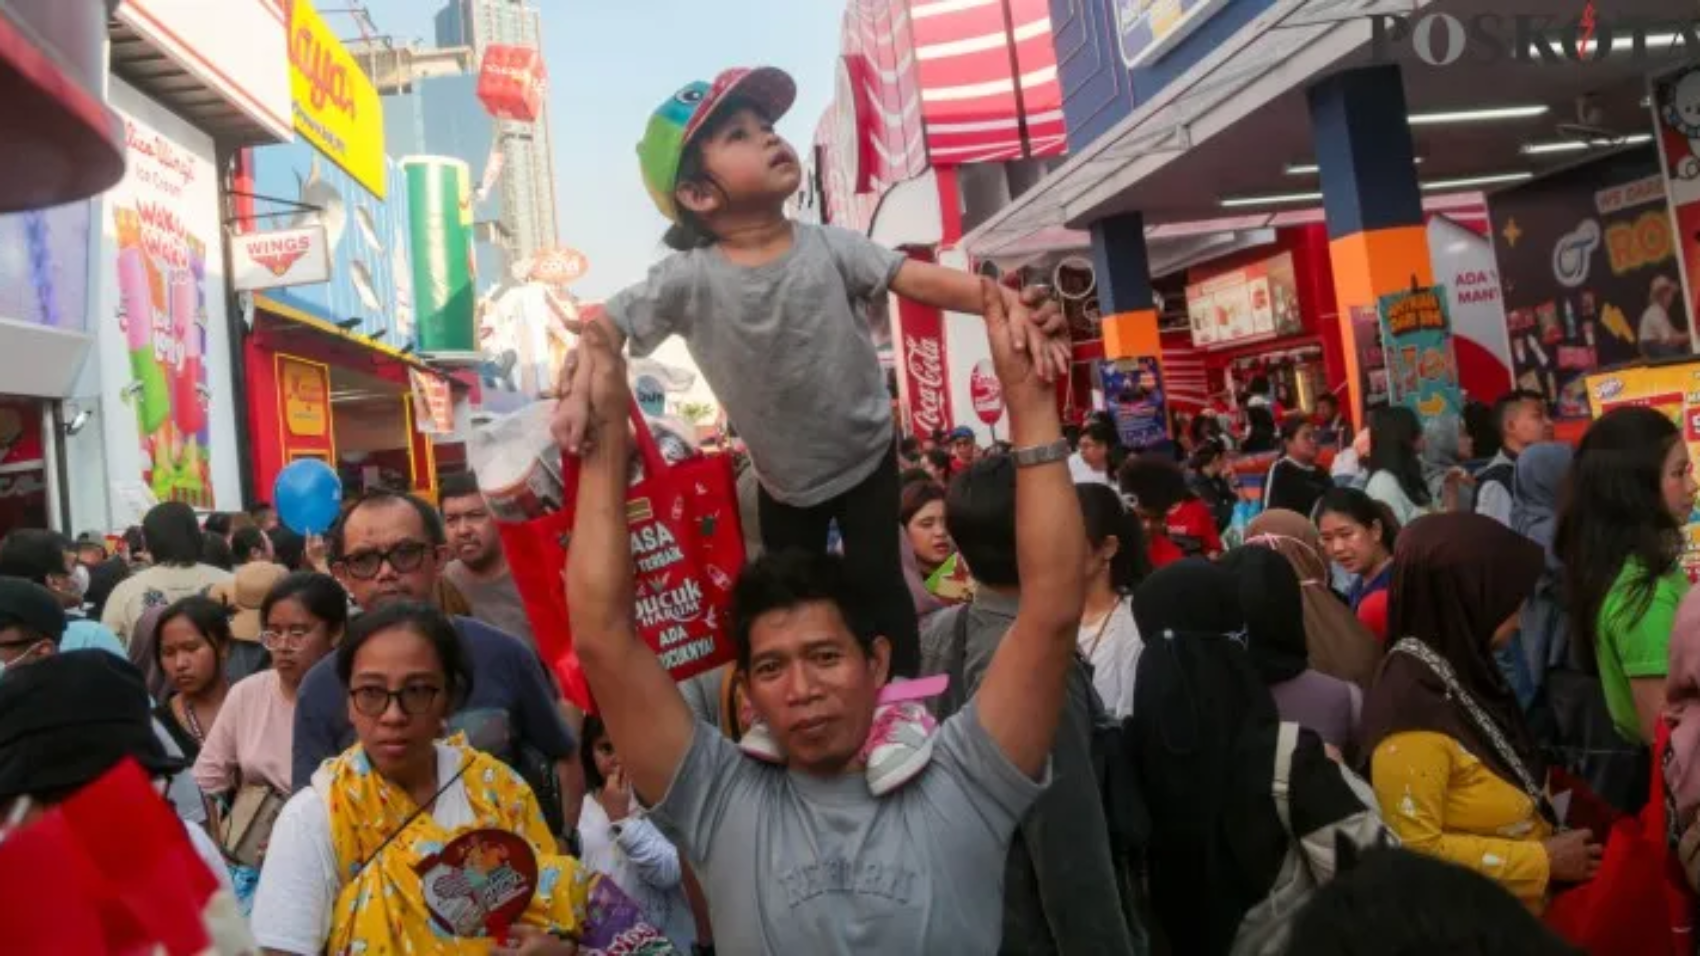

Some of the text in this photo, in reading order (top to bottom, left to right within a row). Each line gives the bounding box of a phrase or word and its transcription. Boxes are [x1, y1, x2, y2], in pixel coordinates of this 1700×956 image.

[246, 236, 310, 254] WINGS
[1456, 271, 1487, 287] ADA
[904, 333, 948, 432] Coca-Cola
[630, 520, 676, 557] ASA
[658, 625, 689, 647] ADA
